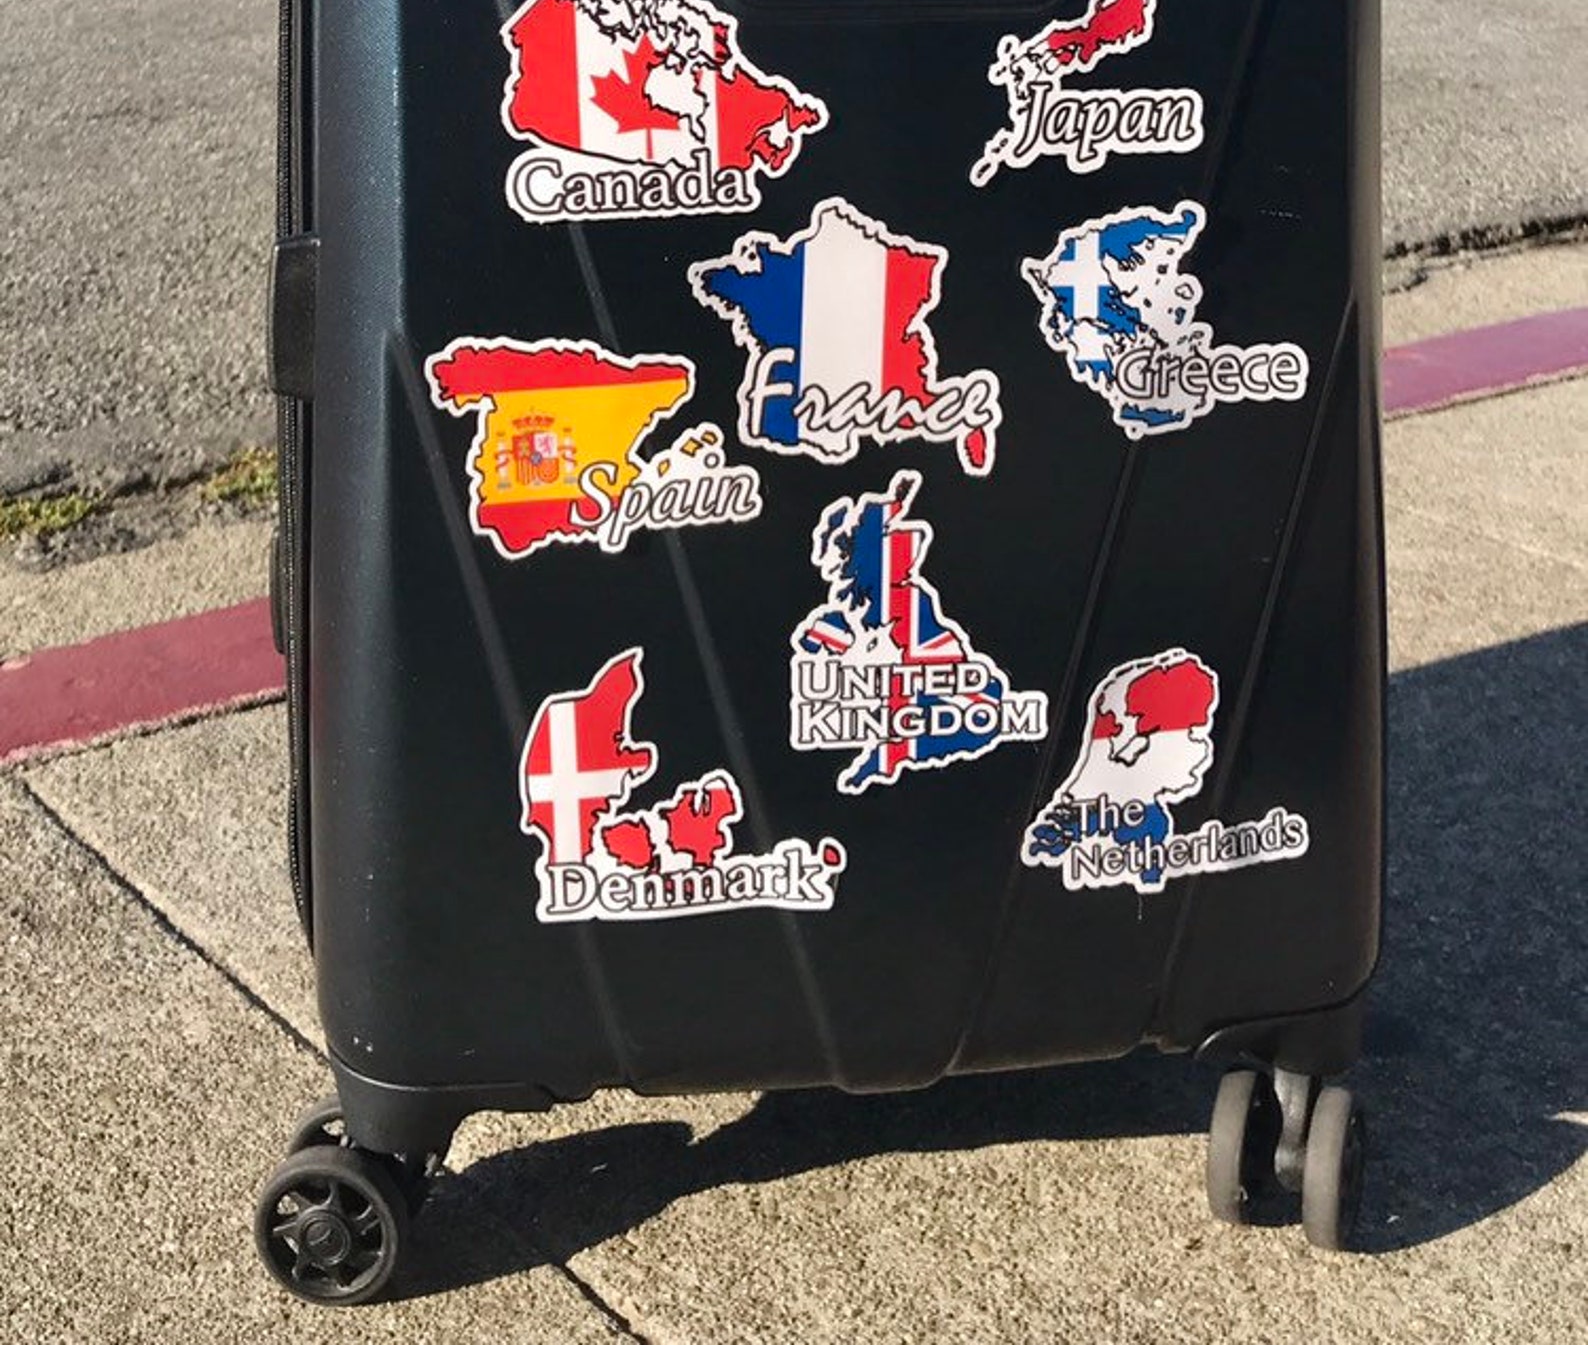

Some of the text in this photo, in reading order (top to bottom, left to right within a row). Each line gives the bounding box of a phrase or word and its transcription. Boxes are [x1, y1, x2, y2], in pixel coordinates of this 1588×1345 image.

[1014, 82, 1196, 164] Japan
[512, 149, 750, 216] Canada
[750, 347, 993, 435] France
[1116, 346, 1301, 400] Greece
[569, 453, 757, 546] Spain
[799, 660, 992, 701] UNITED
[799, 698, 1041, 744] KINGDOM
[1070, 809, 1304, 880] Netherlands
[1071, 792, 1147, 838] The
[548, 848, 825, 914] Denmark
